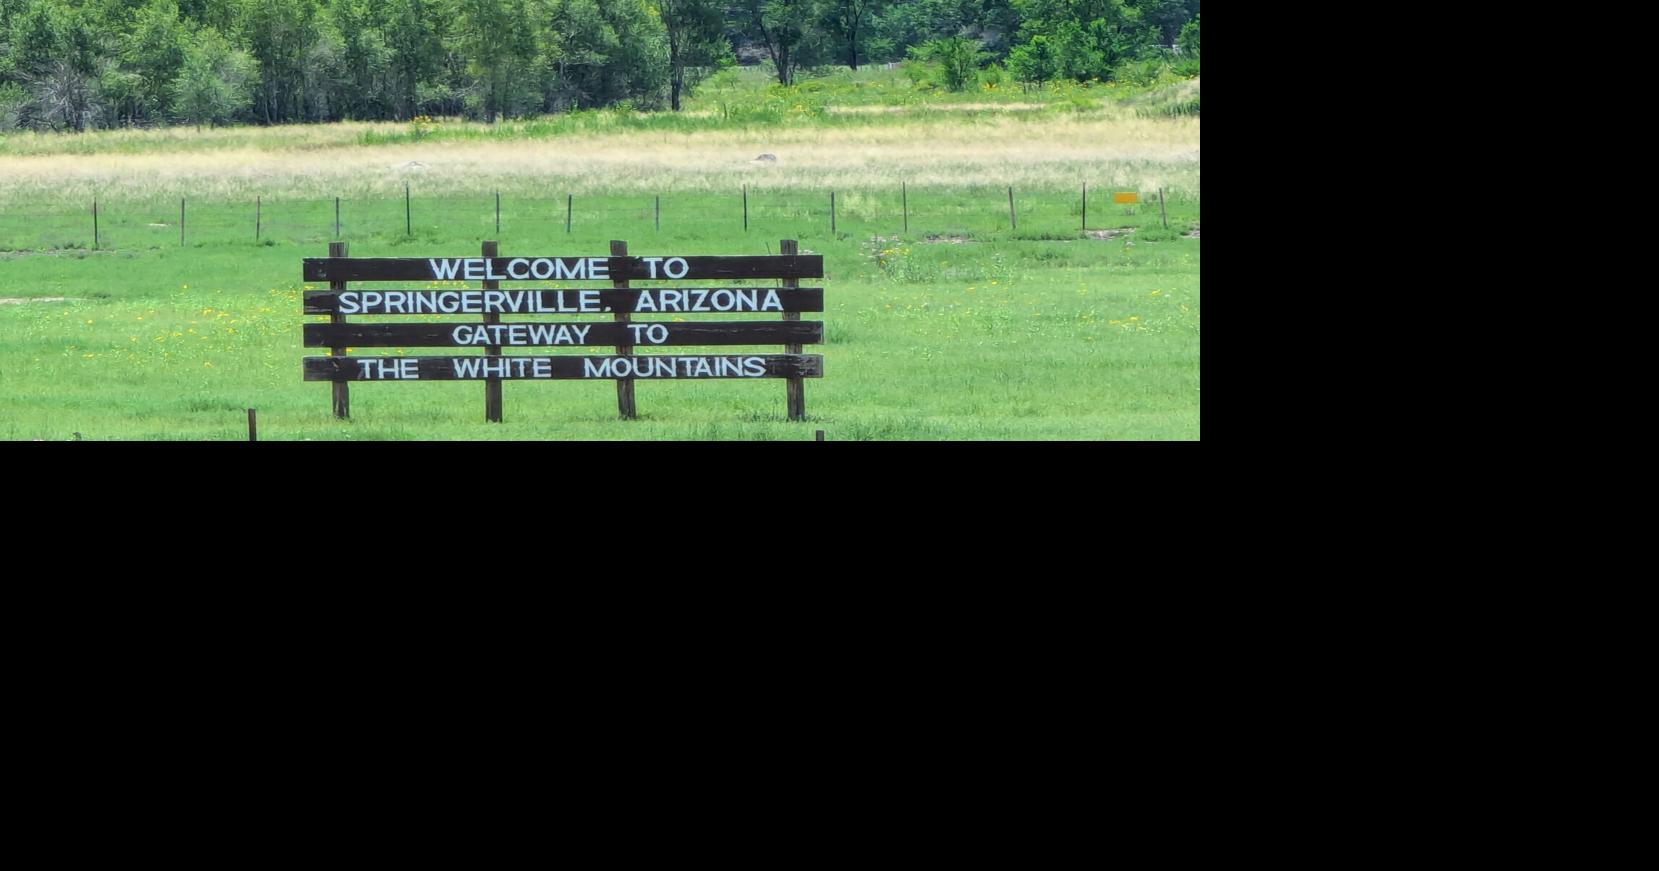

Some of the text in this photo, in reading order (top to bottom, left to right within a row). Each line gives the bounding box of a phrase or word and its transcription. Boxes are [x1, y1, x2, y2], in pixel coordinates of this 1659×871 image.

[430, 257, 690, 280] WELCOME TO
[635, 289, 783, 312] ARIZONA
[452, 324, 669, 346] GATEWAY TO
[357, 356, 767, 379] THE WHITE MOUNTAINS
